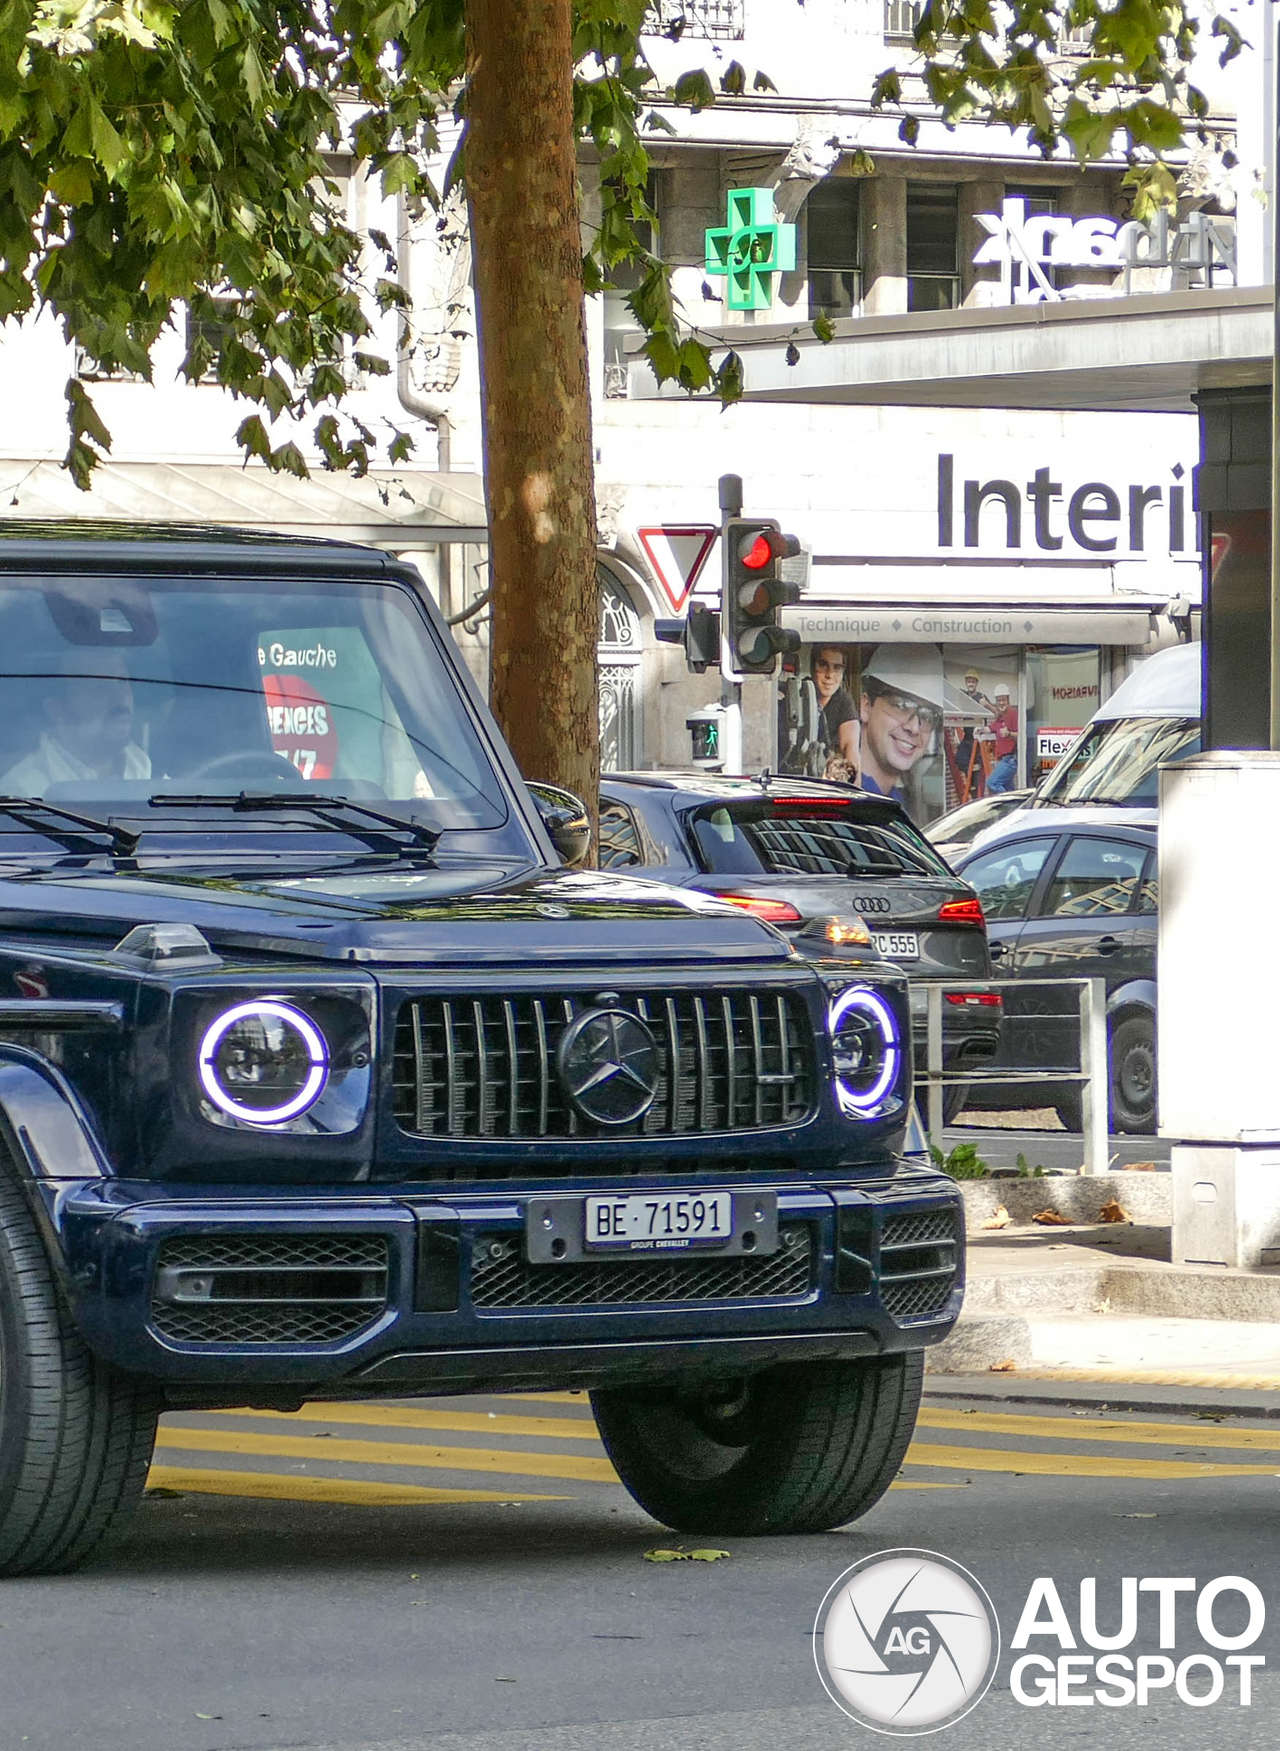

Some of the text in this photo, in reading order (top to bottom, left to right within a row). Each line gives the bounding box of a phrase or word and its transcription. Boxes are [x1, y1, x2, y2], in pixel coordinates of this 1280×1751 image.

[938, 453, 1202, 552] Interi
[798, 616, 1012, 636] Technique Construction
[270, 643, 337, 668] Gauche
[890, 935, 916, 953] 555
[630, 1240, 655, 1250] GROUPE
